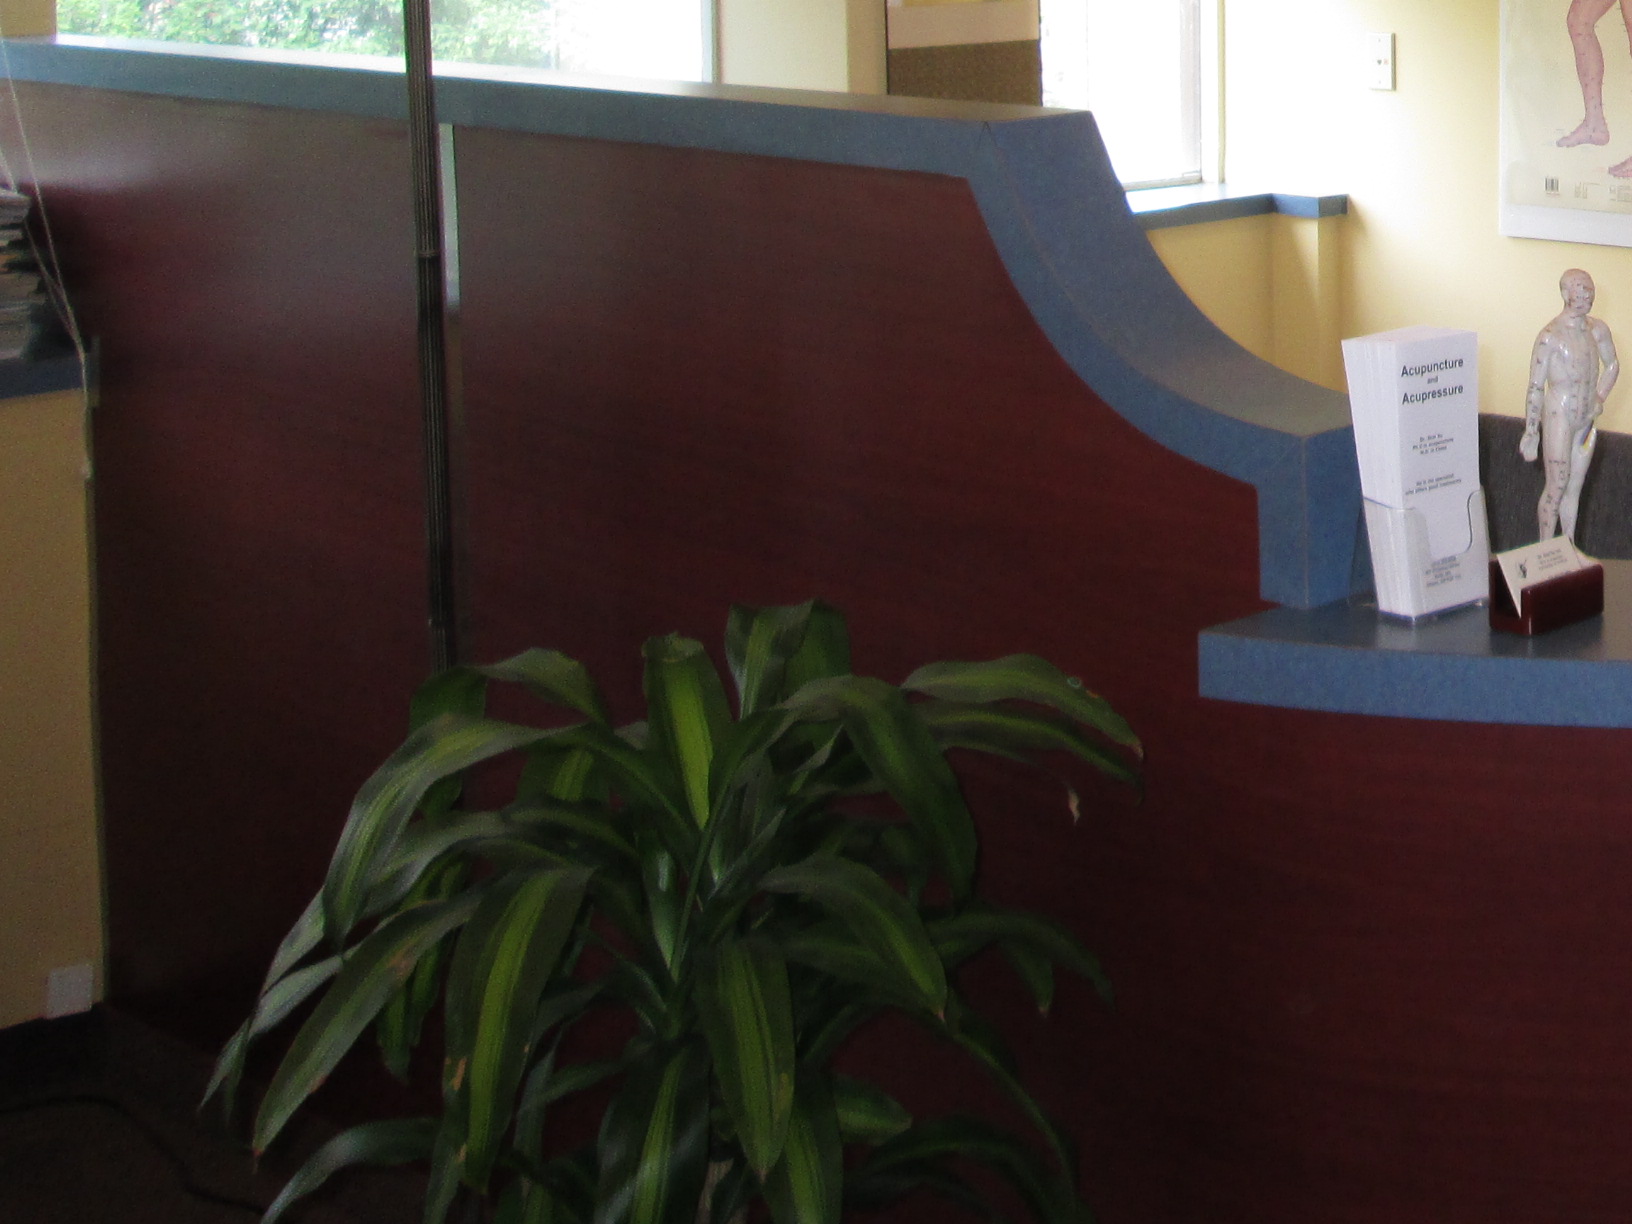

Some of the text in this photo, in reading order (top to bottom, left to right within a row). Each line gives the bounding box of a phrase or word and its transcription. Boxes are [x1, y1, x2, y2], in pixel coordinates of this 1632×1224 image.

[1401, 358, 1464, 377] Acupuncture
[1427, 376, 1439, 384] and
[1402, 385, 1464, 405] Acupressure
